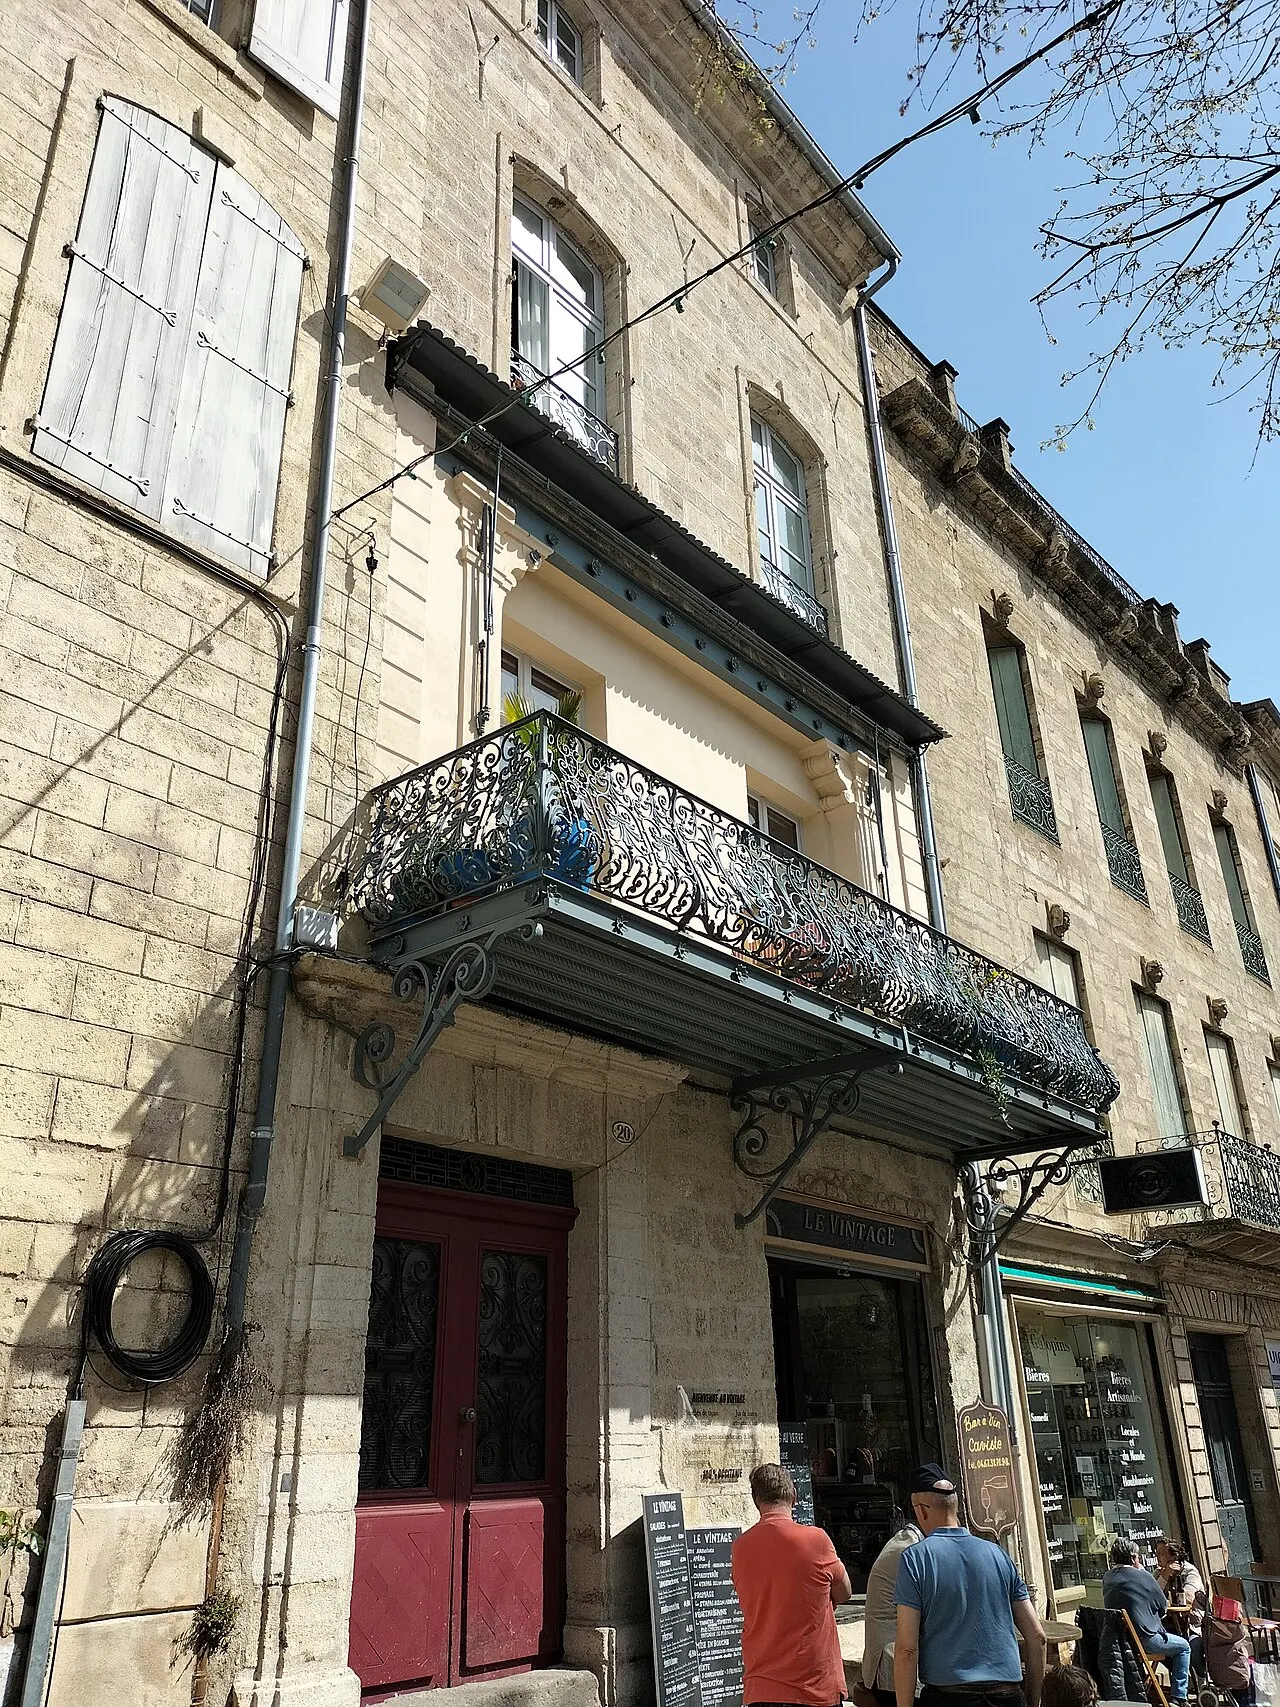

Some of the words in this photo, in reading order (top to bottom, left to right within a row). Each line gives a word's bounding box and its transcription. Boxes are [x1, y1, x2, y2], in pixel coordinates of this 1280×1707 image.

[617, 1124, 630, 1141] 20
[804, 1208, 825, 1232] LE
[830, 1213, 896, 1247] VINTAGE
[1025, 1366, 1050, 1383] Bières
[1110, 1370, 1132, 1386] Bières
[692, 1392, 719, 1404] BIENVENUE
[727, 1393, 746, 1404] VINTAGE
[1107, 1388, 1142, 1403] Artisanales
[963, 1415, 981, 1432] Bar
[988, 1412, 1001, 1429] Vin
[789, 1432, 804, 1444] VERRE
[1120, 1424, 1140, 1437] Locales
[968, 1435, 1003, 1453] Caviste
[652, 1502, 659, 1514] LE
[693, 1533, 701, 1544] LE
[704, 1531, 733, 1544] VINTAGE
[1128, 1528, 1145, 1540] Bières
